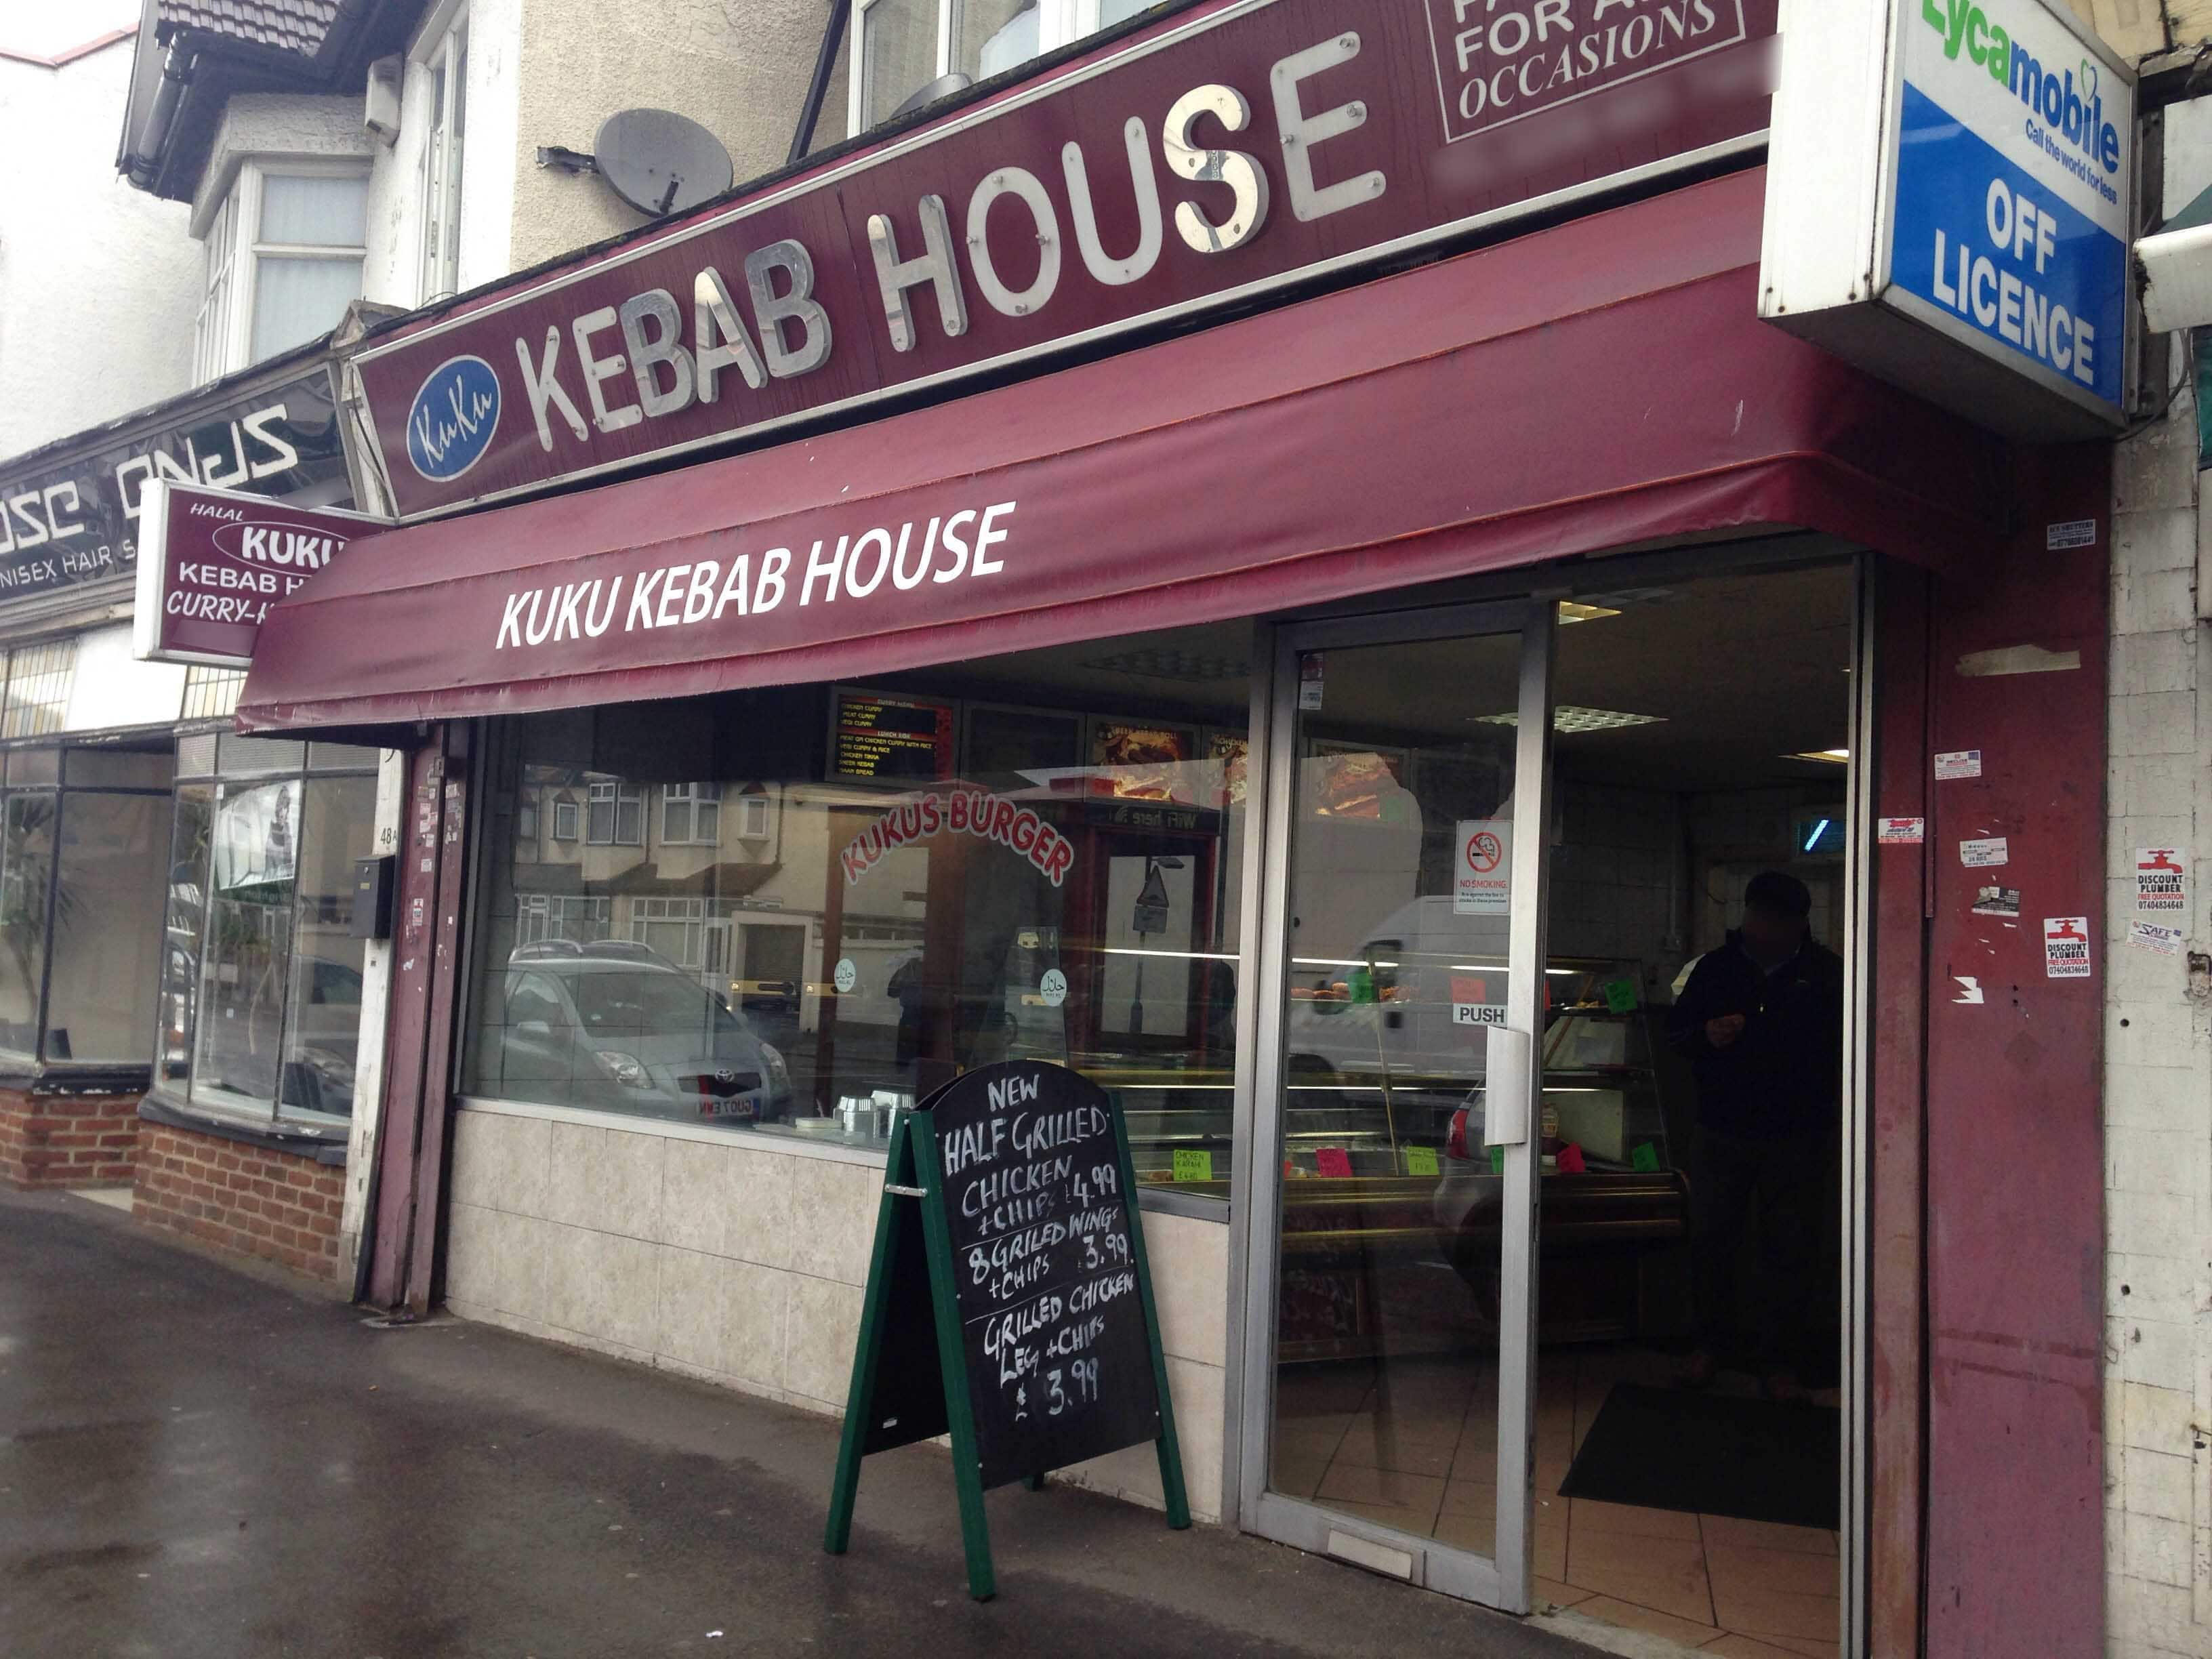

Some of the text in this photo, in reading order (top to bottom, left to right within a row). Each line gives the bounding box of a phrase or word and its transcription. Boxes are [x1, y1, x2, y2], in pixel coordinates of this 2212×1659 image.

[1455, 0, 1575, 73] FOR
[1458, 0, 1716, 119] OCCASIONS
[2026, 119, 2118, 205] Call the world for less
[516, 31, 1387, 452] KEBAB HOUSE
[1986, 178, 2057, 275] OFF
[1933, 228, 2095, 385] LICENCE
[190, 503, 244, 522] HALAL
[62, 545, 113, 574] HAIR
[179, 562, 277, 594] KEBAB
[495, 501, 1017, 650] KUKU KEBAB HOUSE
[841, 792, 1074, 886] KUKUS BURGER
[1460, 879, 1471, 888] NO
[2138, 875, 2184, 884] DISCOUNT
[2141, 884, 2181, 893] PLUMBER
[2047, 943, 2087, 952] DISCOUNT
[2050, 951, 2085, 959] PLUMBER
[1460, 1007, 1504, 1023] PUSH
[987, 1073, 1040, 1111] NEW
[944, 1105, 1107, 1177] HALF GRILLED
[962, 1155, 1073, 1218] CHICKEN
[968, 1247, 991, 1285] 8
[985, 1273, 1134, 1361] GRILLED CHICKEN
[1000, 1345, 1040, 1389] LEG
